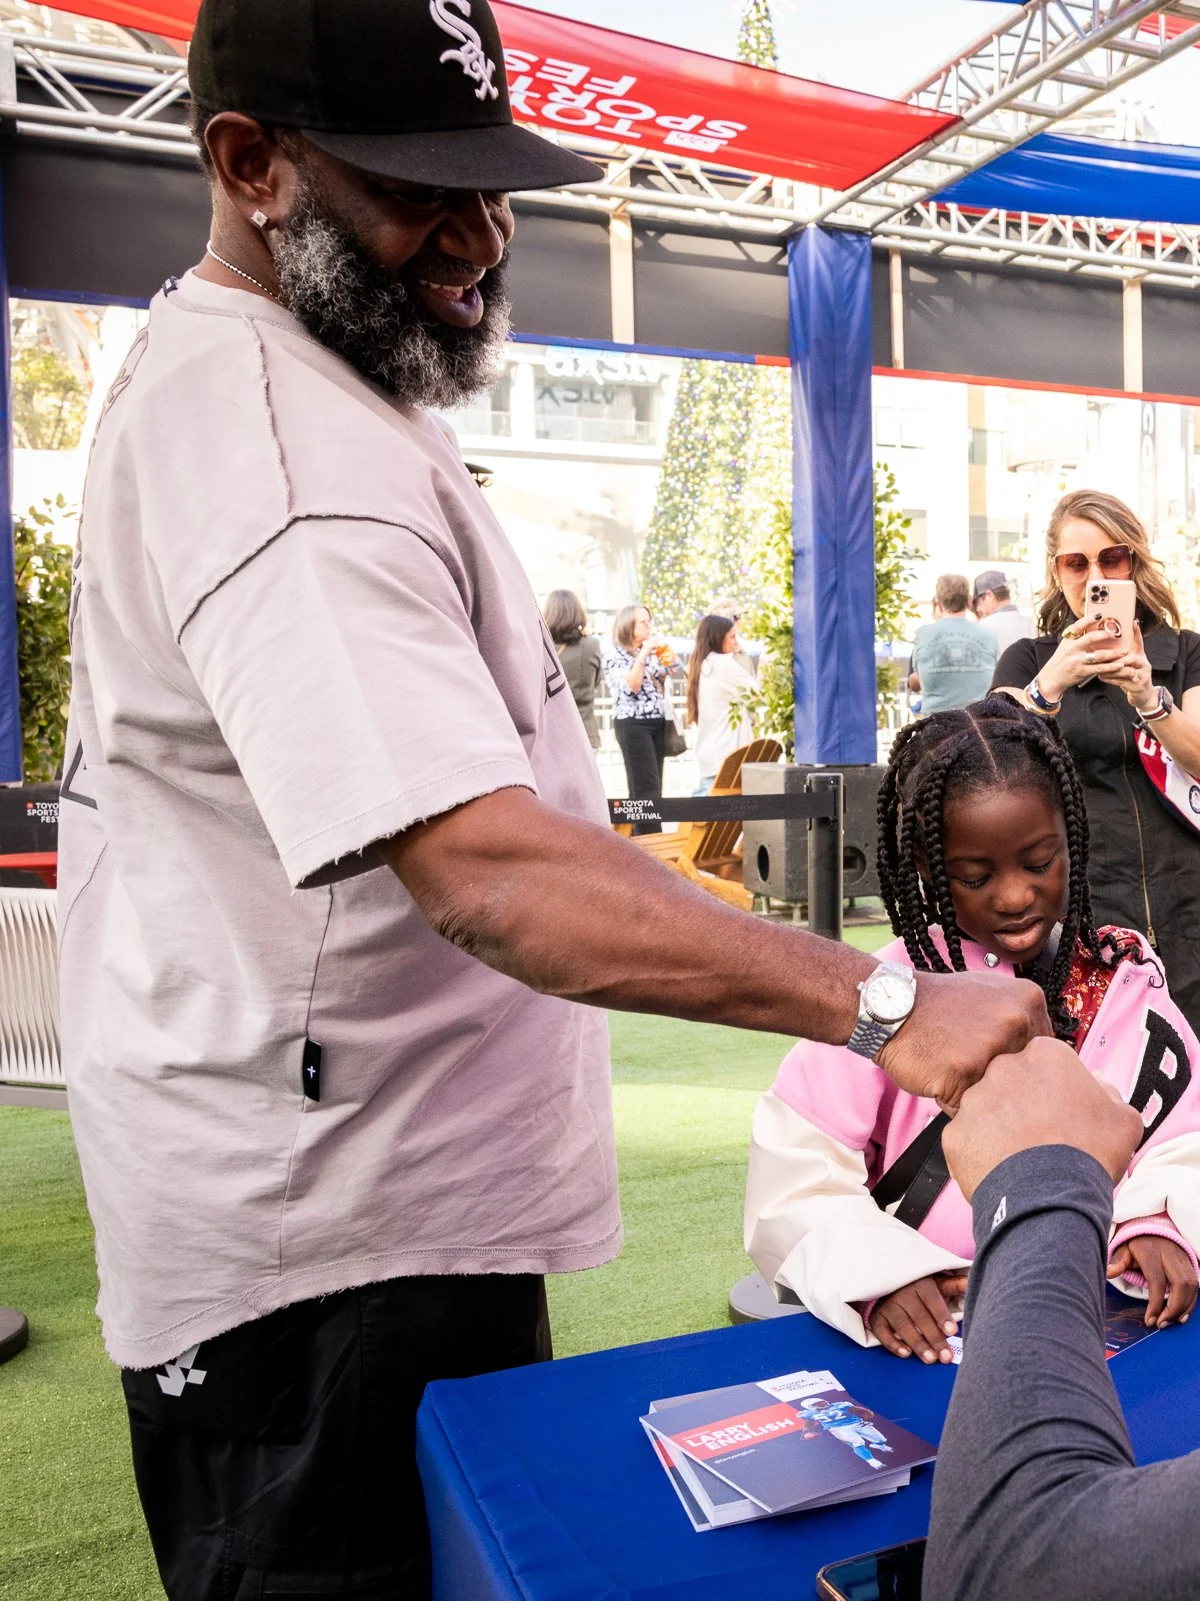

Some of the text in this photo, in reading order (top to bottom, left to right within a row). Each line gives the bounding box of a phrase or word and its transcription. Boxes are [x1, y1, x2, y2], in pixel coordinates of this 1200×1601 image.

[503, 47, 637, 98] FES
[508, 75, 748, 140] SPORT
[508, 90, 642, 139] TOY
[26, 808, 59, 816] SPORTS
[613, 806, 643, 814] SPORTS
[621, 799, 654, 807] TOYOTA
[685, 1421, 751, 1448] LARRY
[704, 1418, 796, 1451] ENGLISH
